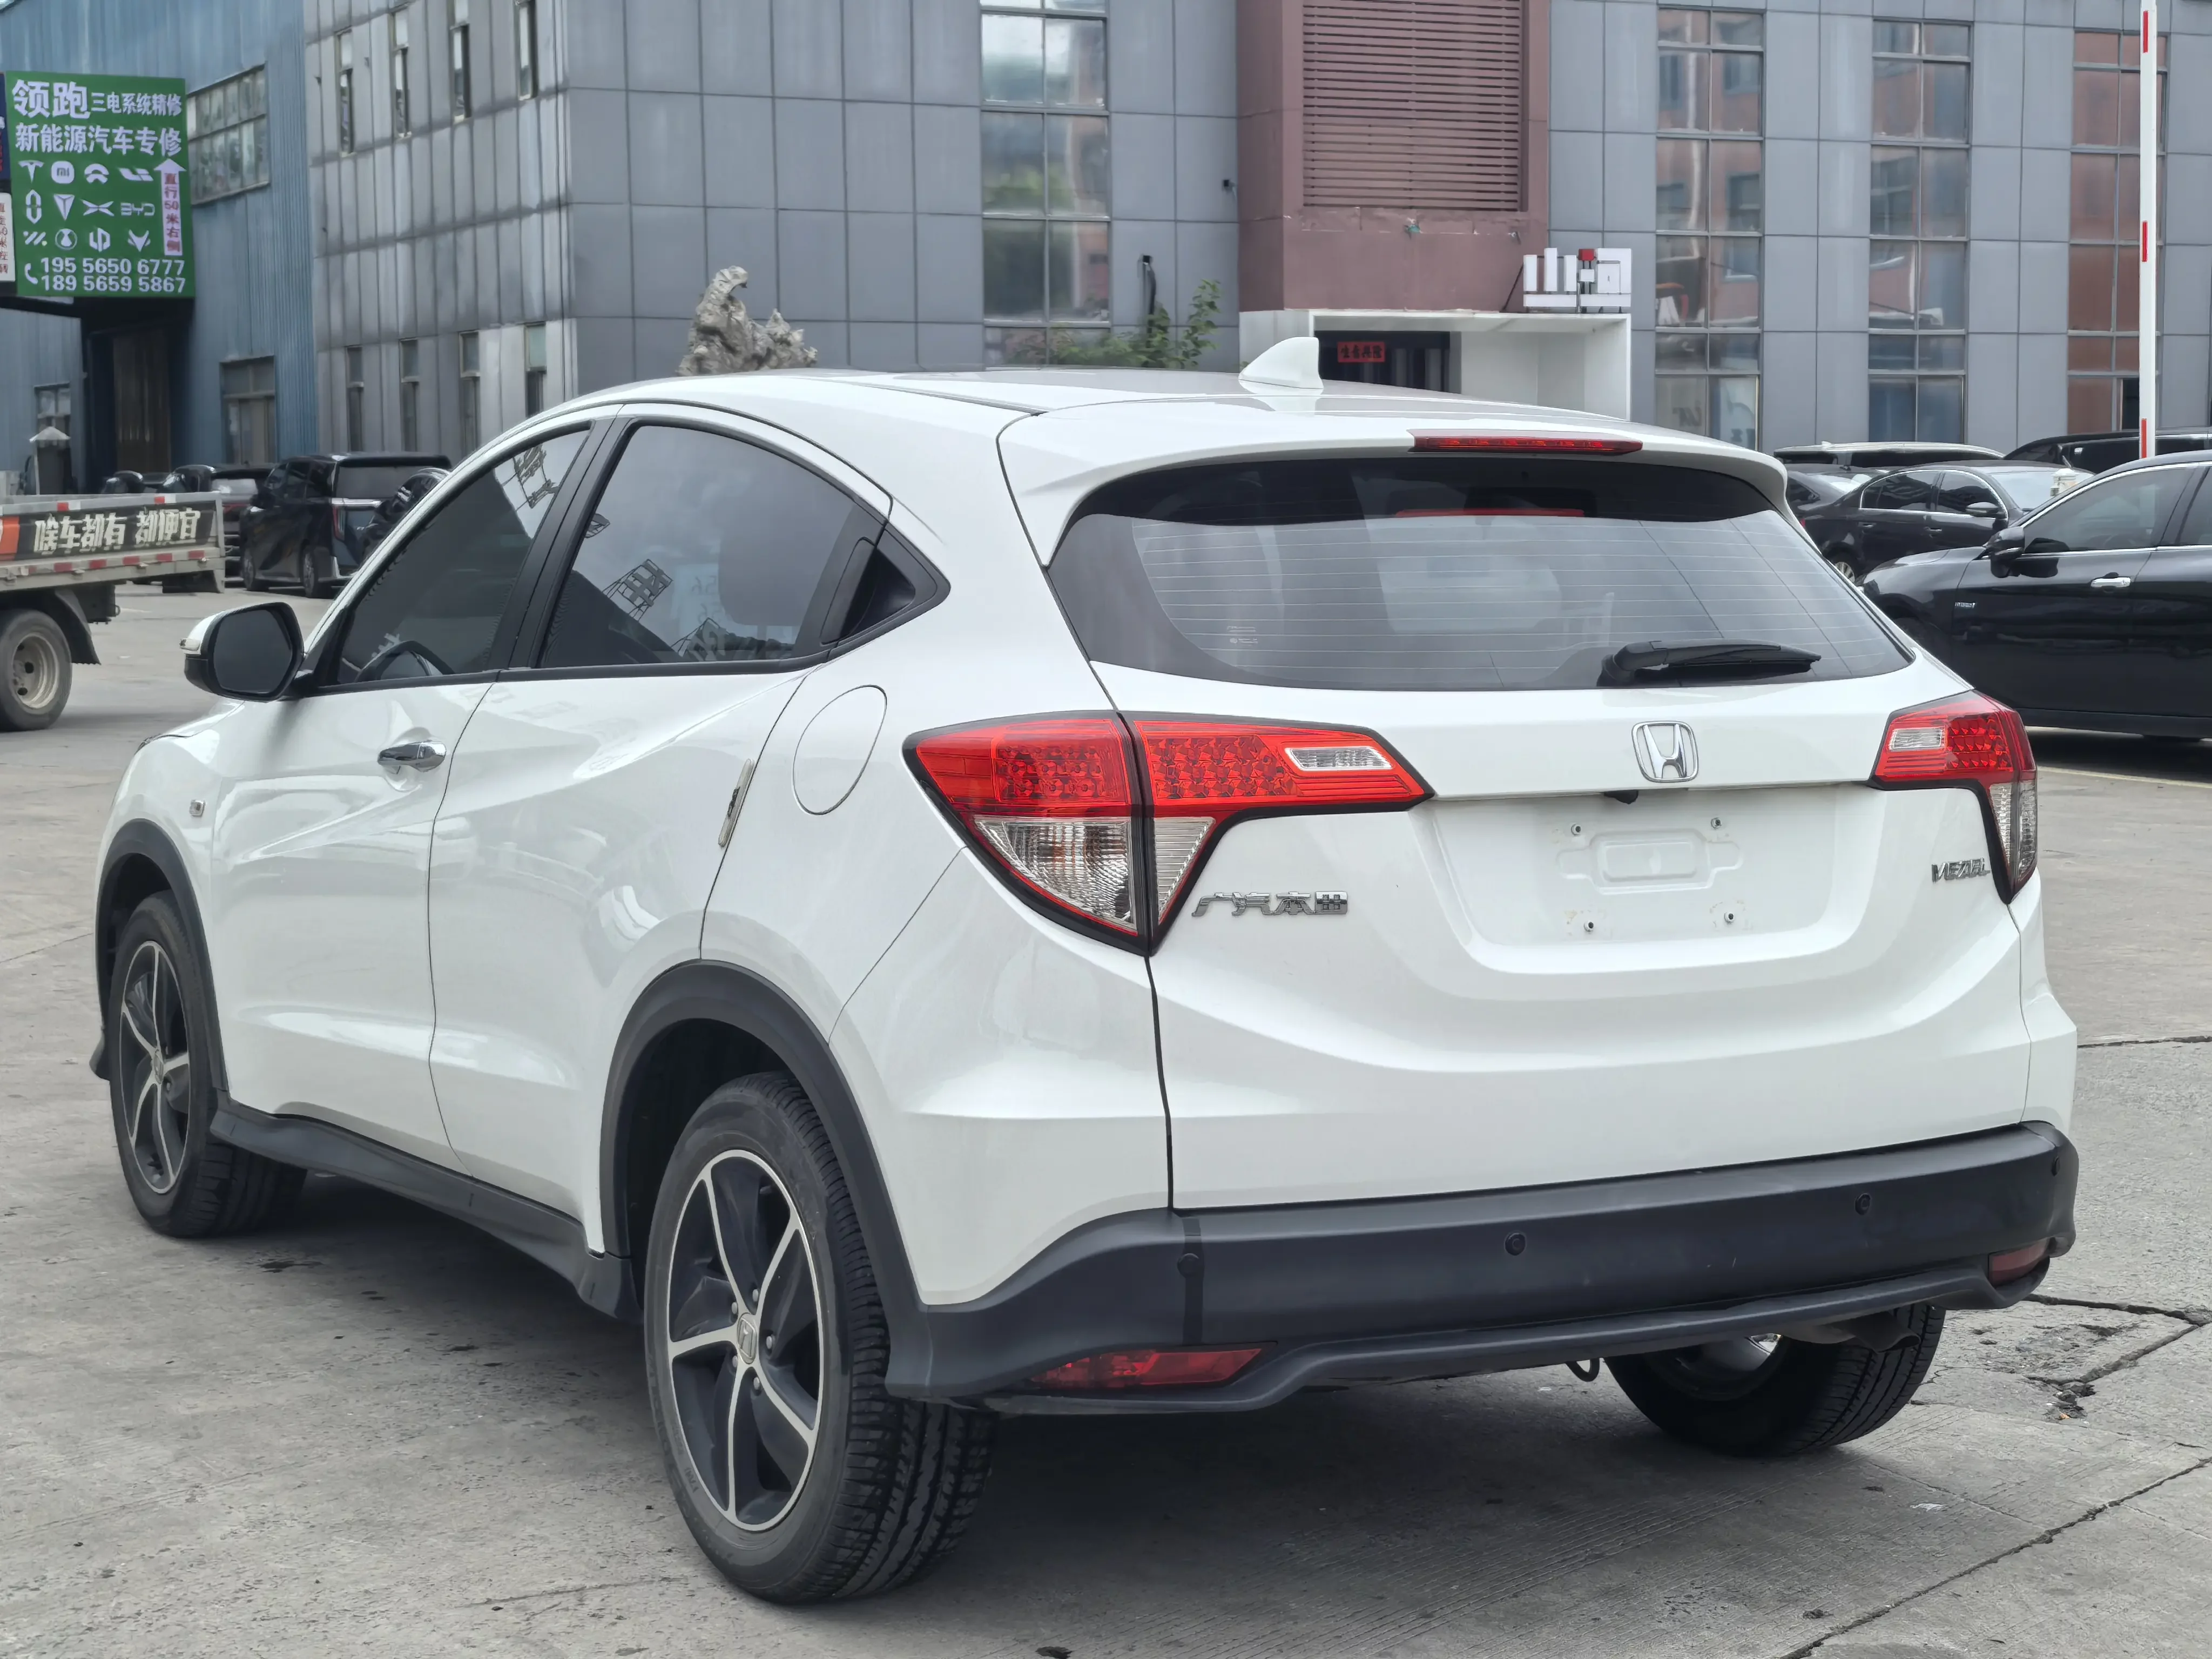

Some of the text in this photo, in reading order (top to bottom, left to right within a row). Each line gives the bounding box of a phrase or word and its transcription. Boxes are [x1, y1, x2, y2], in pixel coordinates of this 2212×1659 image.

[12, 79, 91, 119] 领跑
[16, 122, 182, 156] 新能源汽车专修
[41, 257, 184, 275] 195 5650 6777
[42, 274, 186, 293] 189 5659 5867
[1191, 892, 1347, 917] 广汽本田
